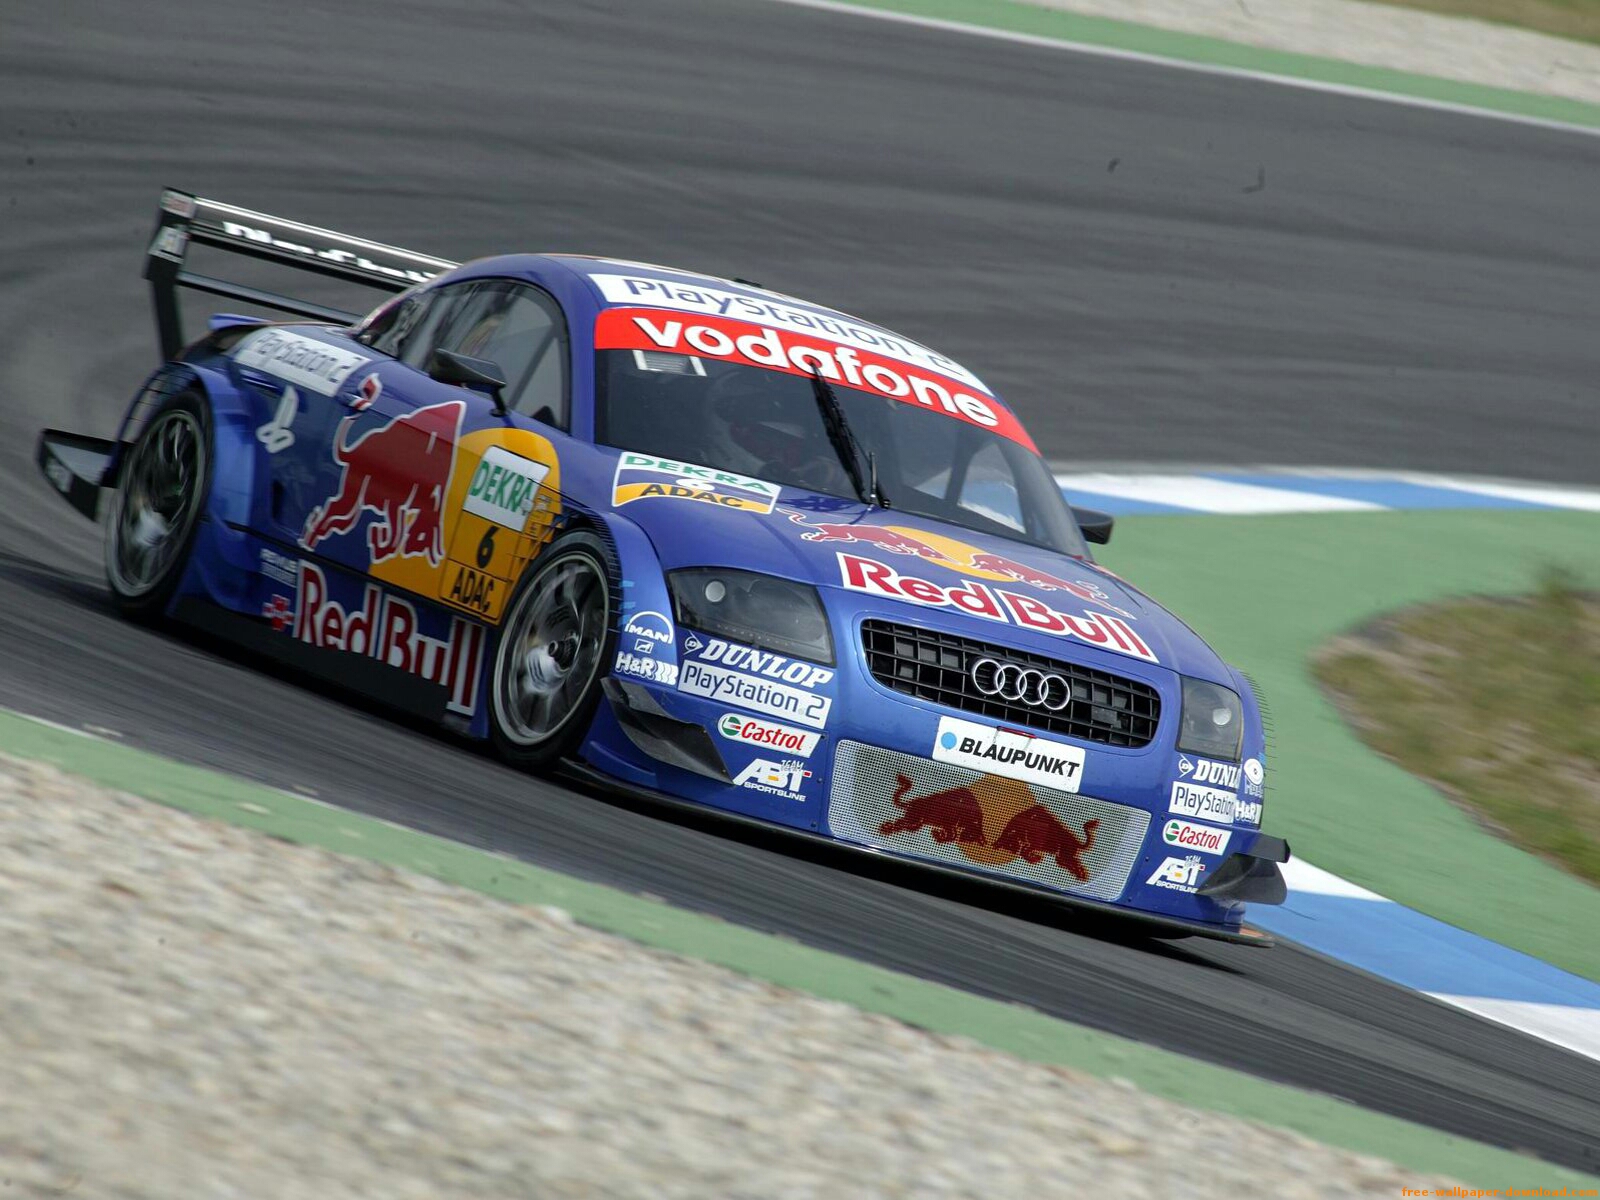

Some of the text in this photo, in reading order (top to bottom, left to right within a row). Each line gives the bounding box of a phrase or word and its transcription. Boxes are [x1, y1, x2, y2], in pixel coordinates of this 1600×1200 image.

[624, 279, 912, 356] PlayStation
[632, 317, 998, 427] vodafone
[470, 461, 533, 513] DEKRA
[624, 455, 772, 493] DEKRA
[640, 484, 743, 508] ADAC
[476, 525, 499, 569] 6
[451, 567, 494, 613] ADAC
[835, 551, 1160, 664] Red Bull
[292, 559, 487, 717] Red Bull
[629, 624, 669, 643] MAN
[699, 639, 833, 688] DUNLOP
[684, 665, 826, 721] PlayStation 2
[741, 721, 808, 751] Castrol
[958, 737, 1080, 778] BLAUPUNKT
[732, 758, 813, 792] ABT
[743, 781, 806, 802] SPORTSLINE
[1179, 826, 1223, 850] Castrol
